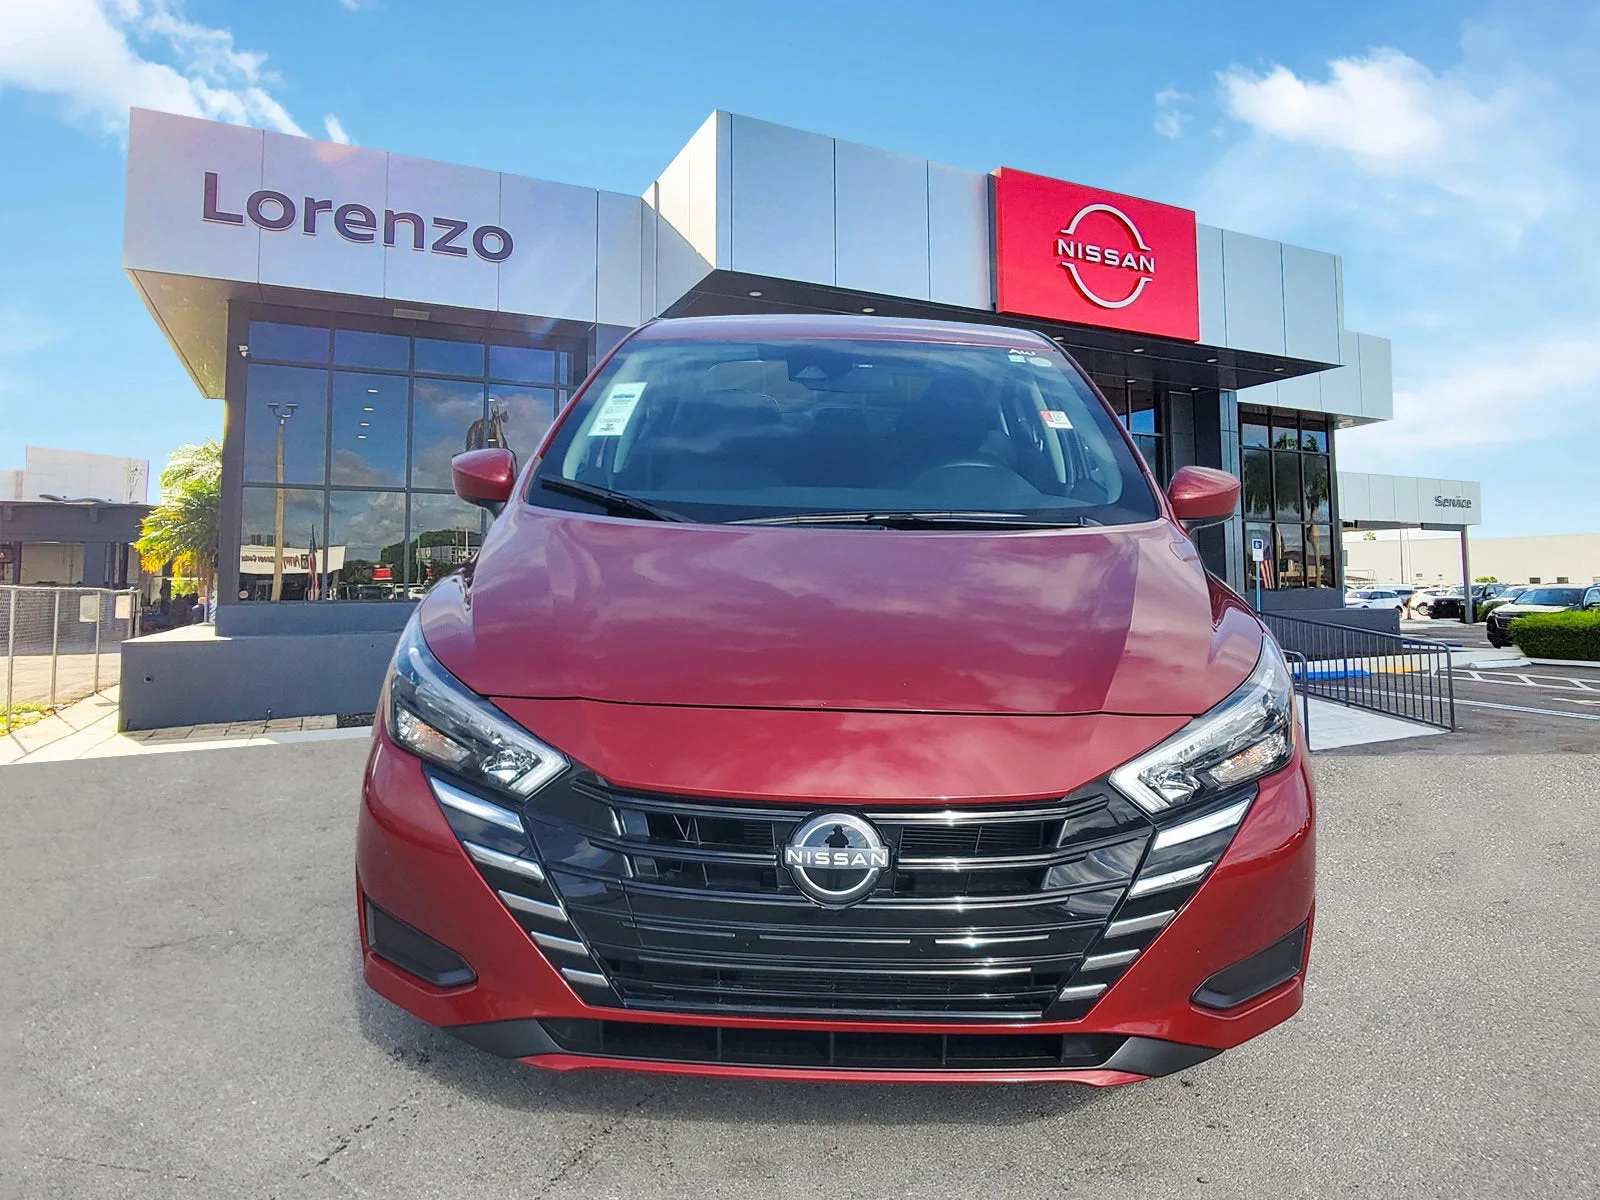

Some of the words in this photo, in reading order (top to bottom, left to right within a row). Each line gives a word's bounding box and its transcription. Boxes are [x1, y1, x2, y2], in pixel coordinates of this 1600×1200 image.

[202, 171, 514, 262] Lorenzo
[1057, 238, 1155, 273] NISSAN
[1434, 495, 1472, 509] Service
[787, 849, 886, 866] NISSAN
